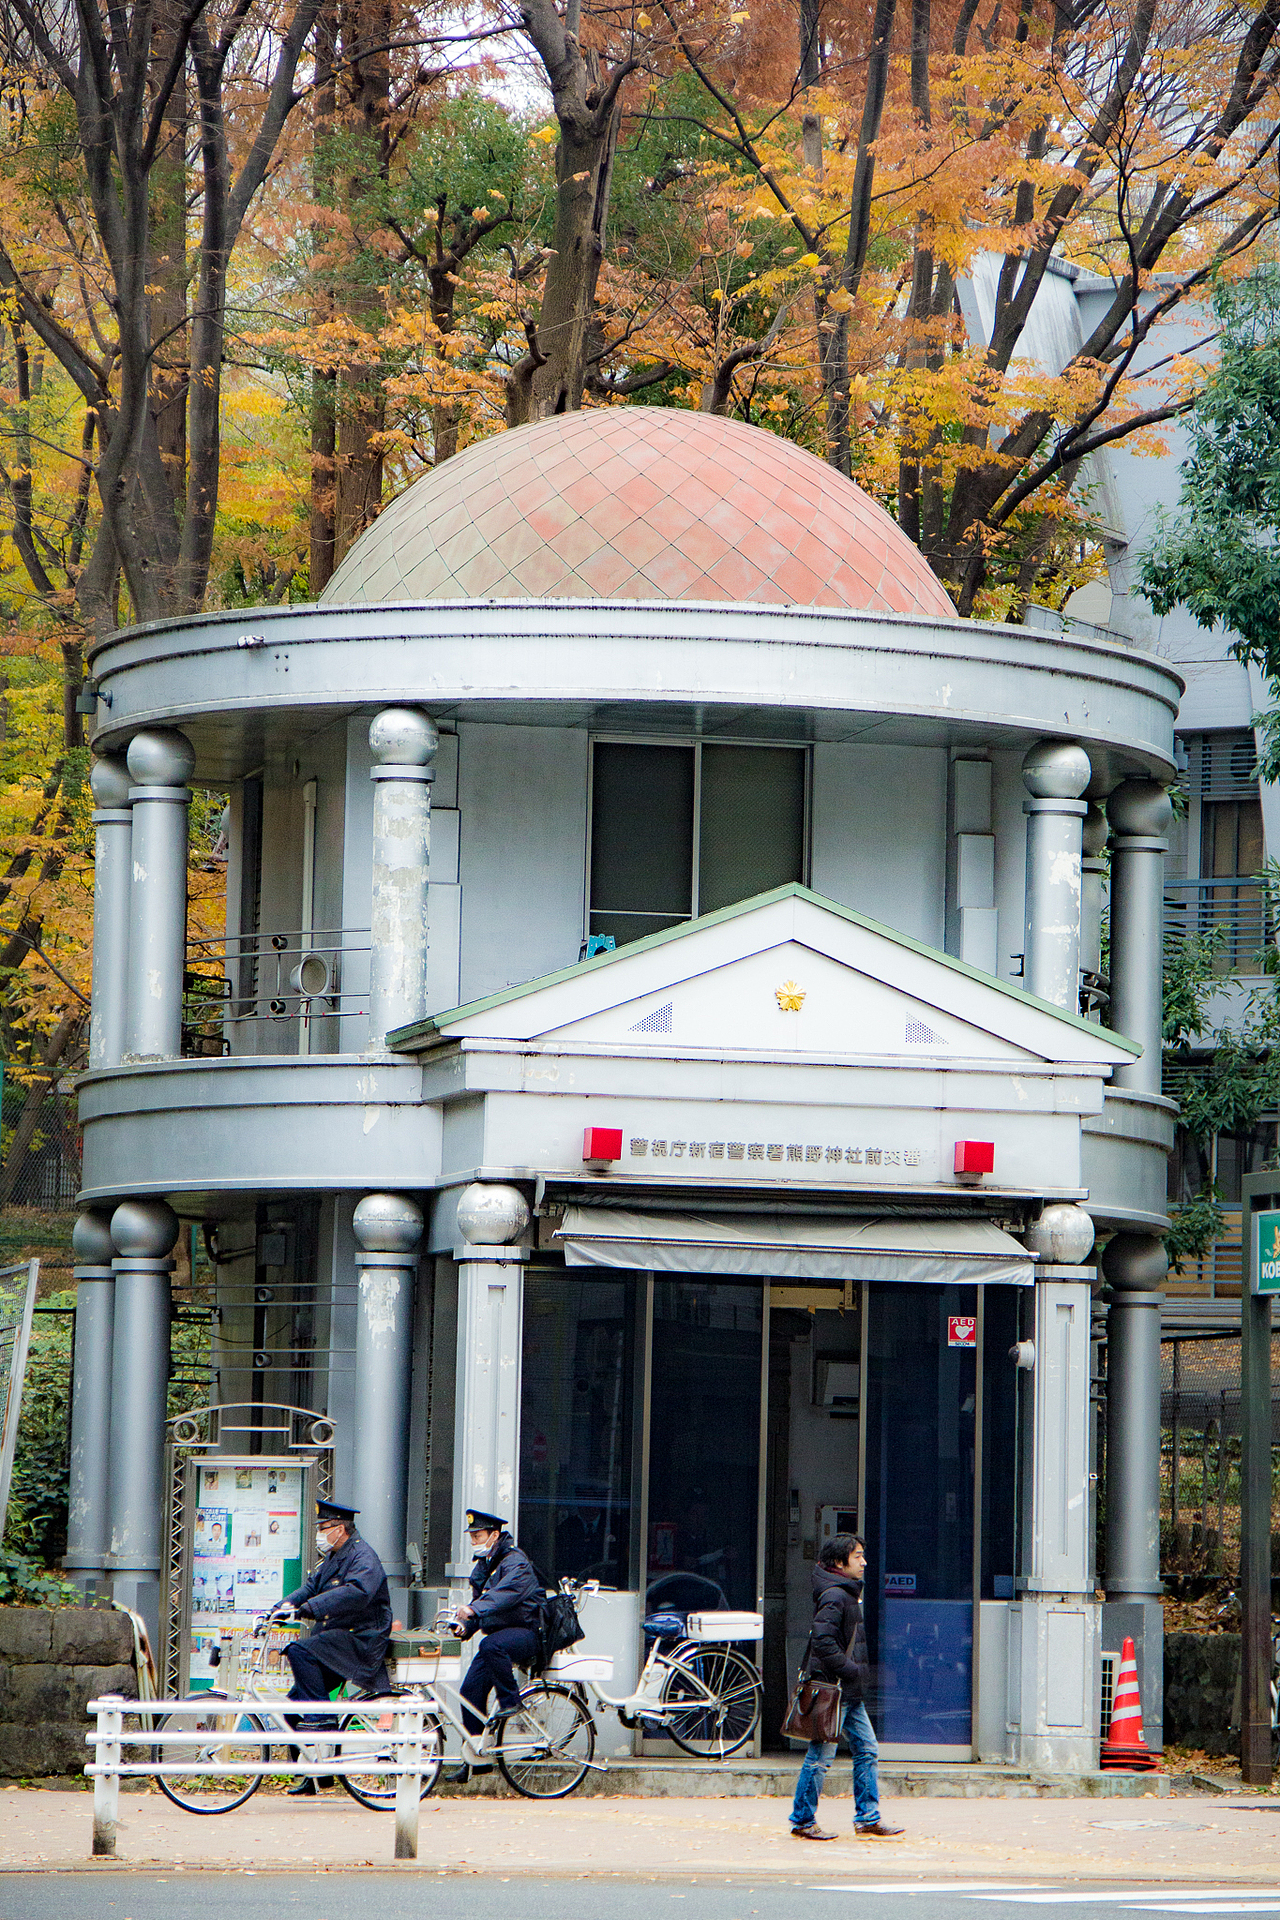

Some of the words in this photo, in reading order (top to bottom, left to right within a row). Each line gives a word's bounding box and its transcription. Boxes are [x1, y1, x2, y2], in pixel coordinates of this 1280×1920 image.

[629, 1137, 921, 1167] 警視庁新宿警察署熊野神社前交番
[951, 1318, 974, 1326] AED
[889, 1576, 915, 1585] AED
